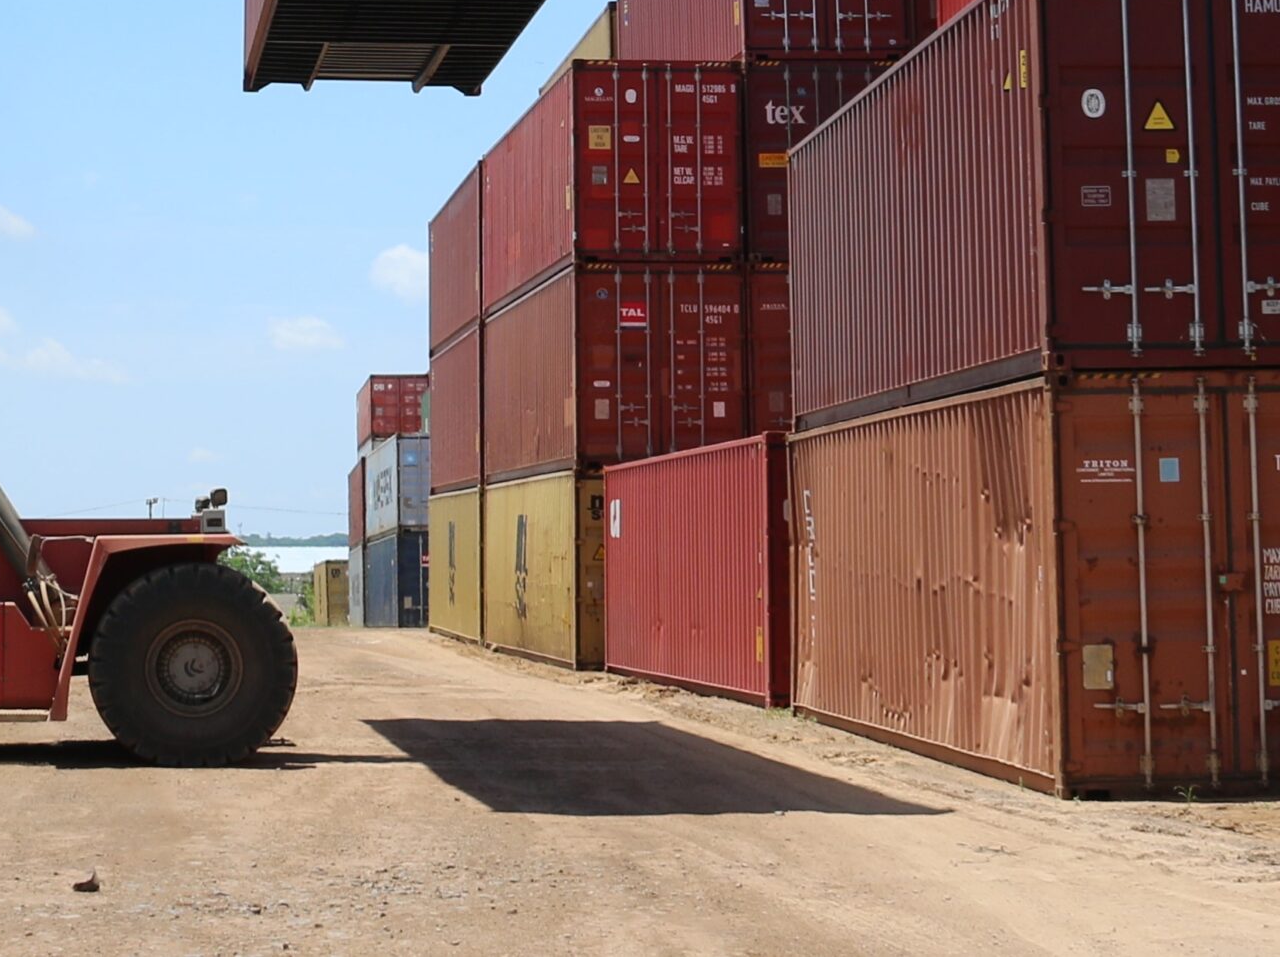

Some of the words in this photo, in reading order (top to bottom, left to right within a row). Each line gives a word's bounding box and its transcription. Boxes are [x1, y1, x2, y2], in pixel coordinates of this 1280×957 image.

[764, 99, 807, 124] tex
[620, 308, 645, 317] TAL
[680, 304, 698, 313] TCLU
[1083, 459, 1128, 468] TRITON
